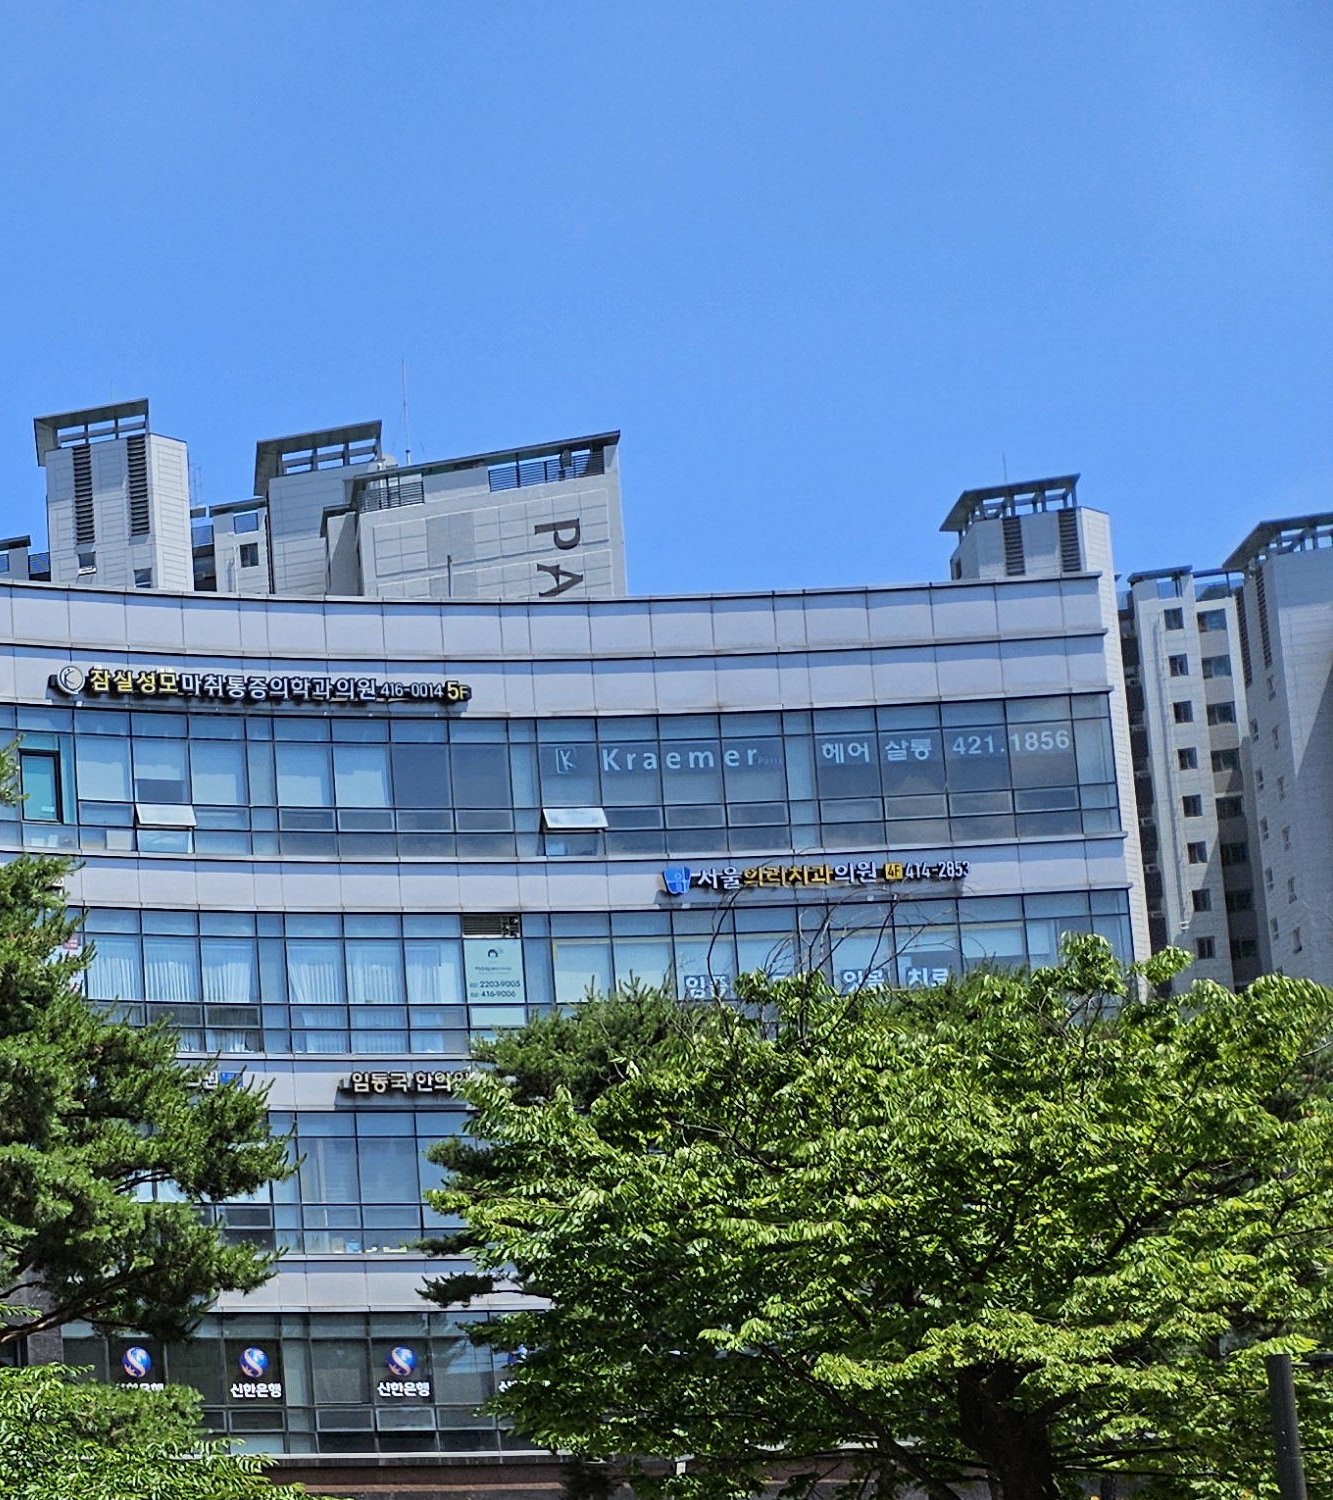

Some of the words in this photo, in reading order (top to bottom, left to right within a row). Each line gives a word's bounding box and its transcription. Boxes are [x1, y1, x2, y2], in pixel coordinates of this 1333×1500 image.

[380, 682, 443, 698] 416-0014
[447, 681, 469, 700] 5F
[821, 742, 869, 763] 헤어
[885, 738, 932, 761] 살롱
[952, 730, 1071, 755] 421.1856
[602, 749, 757, 771] Kraemer
[886, 863, 902, 879] 4F
[905, 860, 970, 879] 414-2853
[352, 1071, 407, 1093] 임동국
[230, 1382, 282, 1398] 신한은행
[377, 1381, 430, 1398] 신한은행
